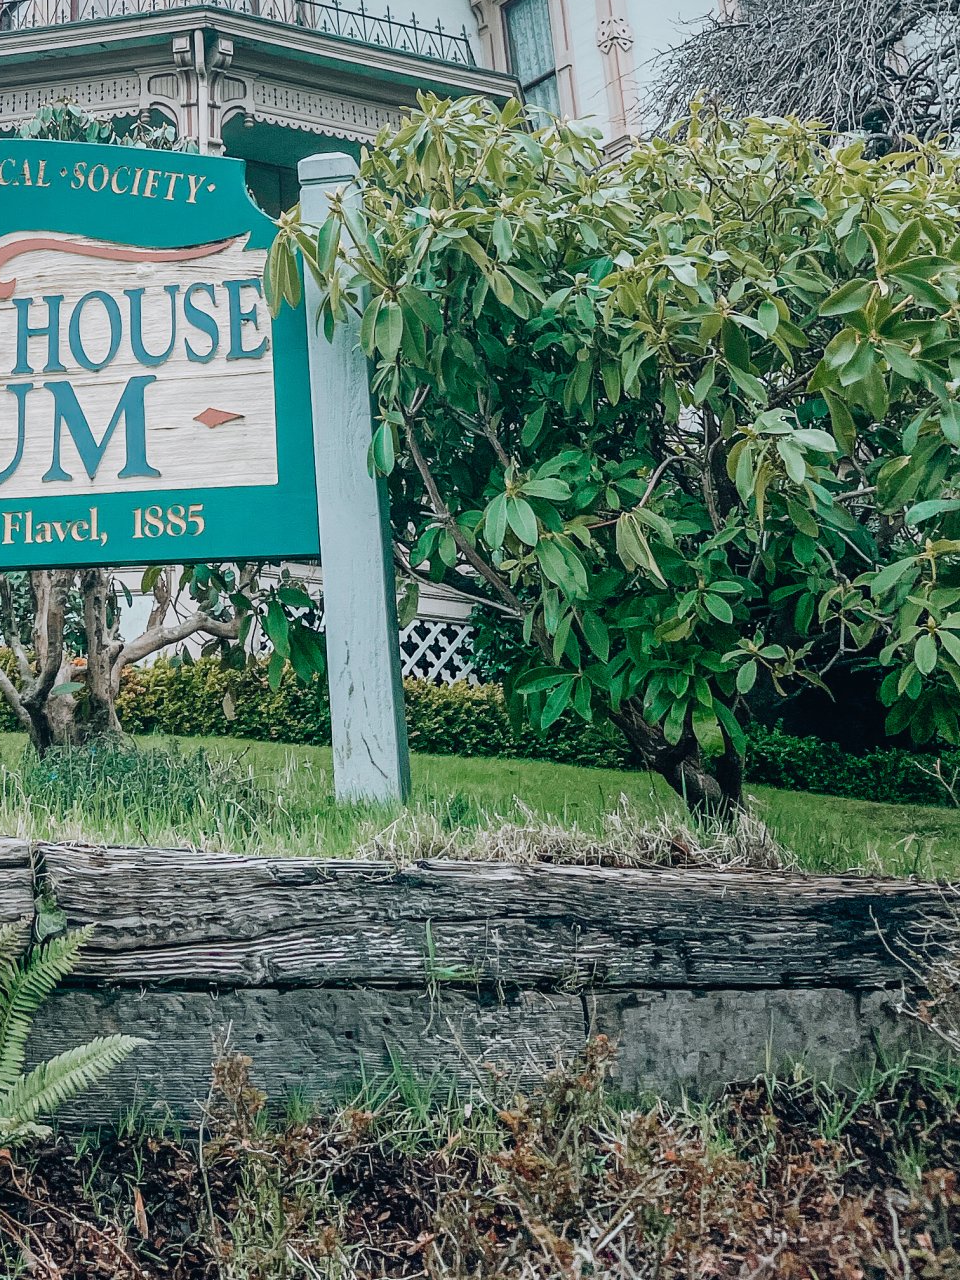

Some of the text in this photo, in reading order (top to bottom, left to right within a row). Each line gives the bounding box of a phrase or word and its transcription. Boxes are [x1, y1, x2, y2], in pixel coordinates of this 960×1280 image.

[70, 161, 208, 204] SOCIETY
[11, 277, 270, 375] HOUSE
[1, 506, 109, 548] Flavel,
[131, 502, 206, 540] 1885
